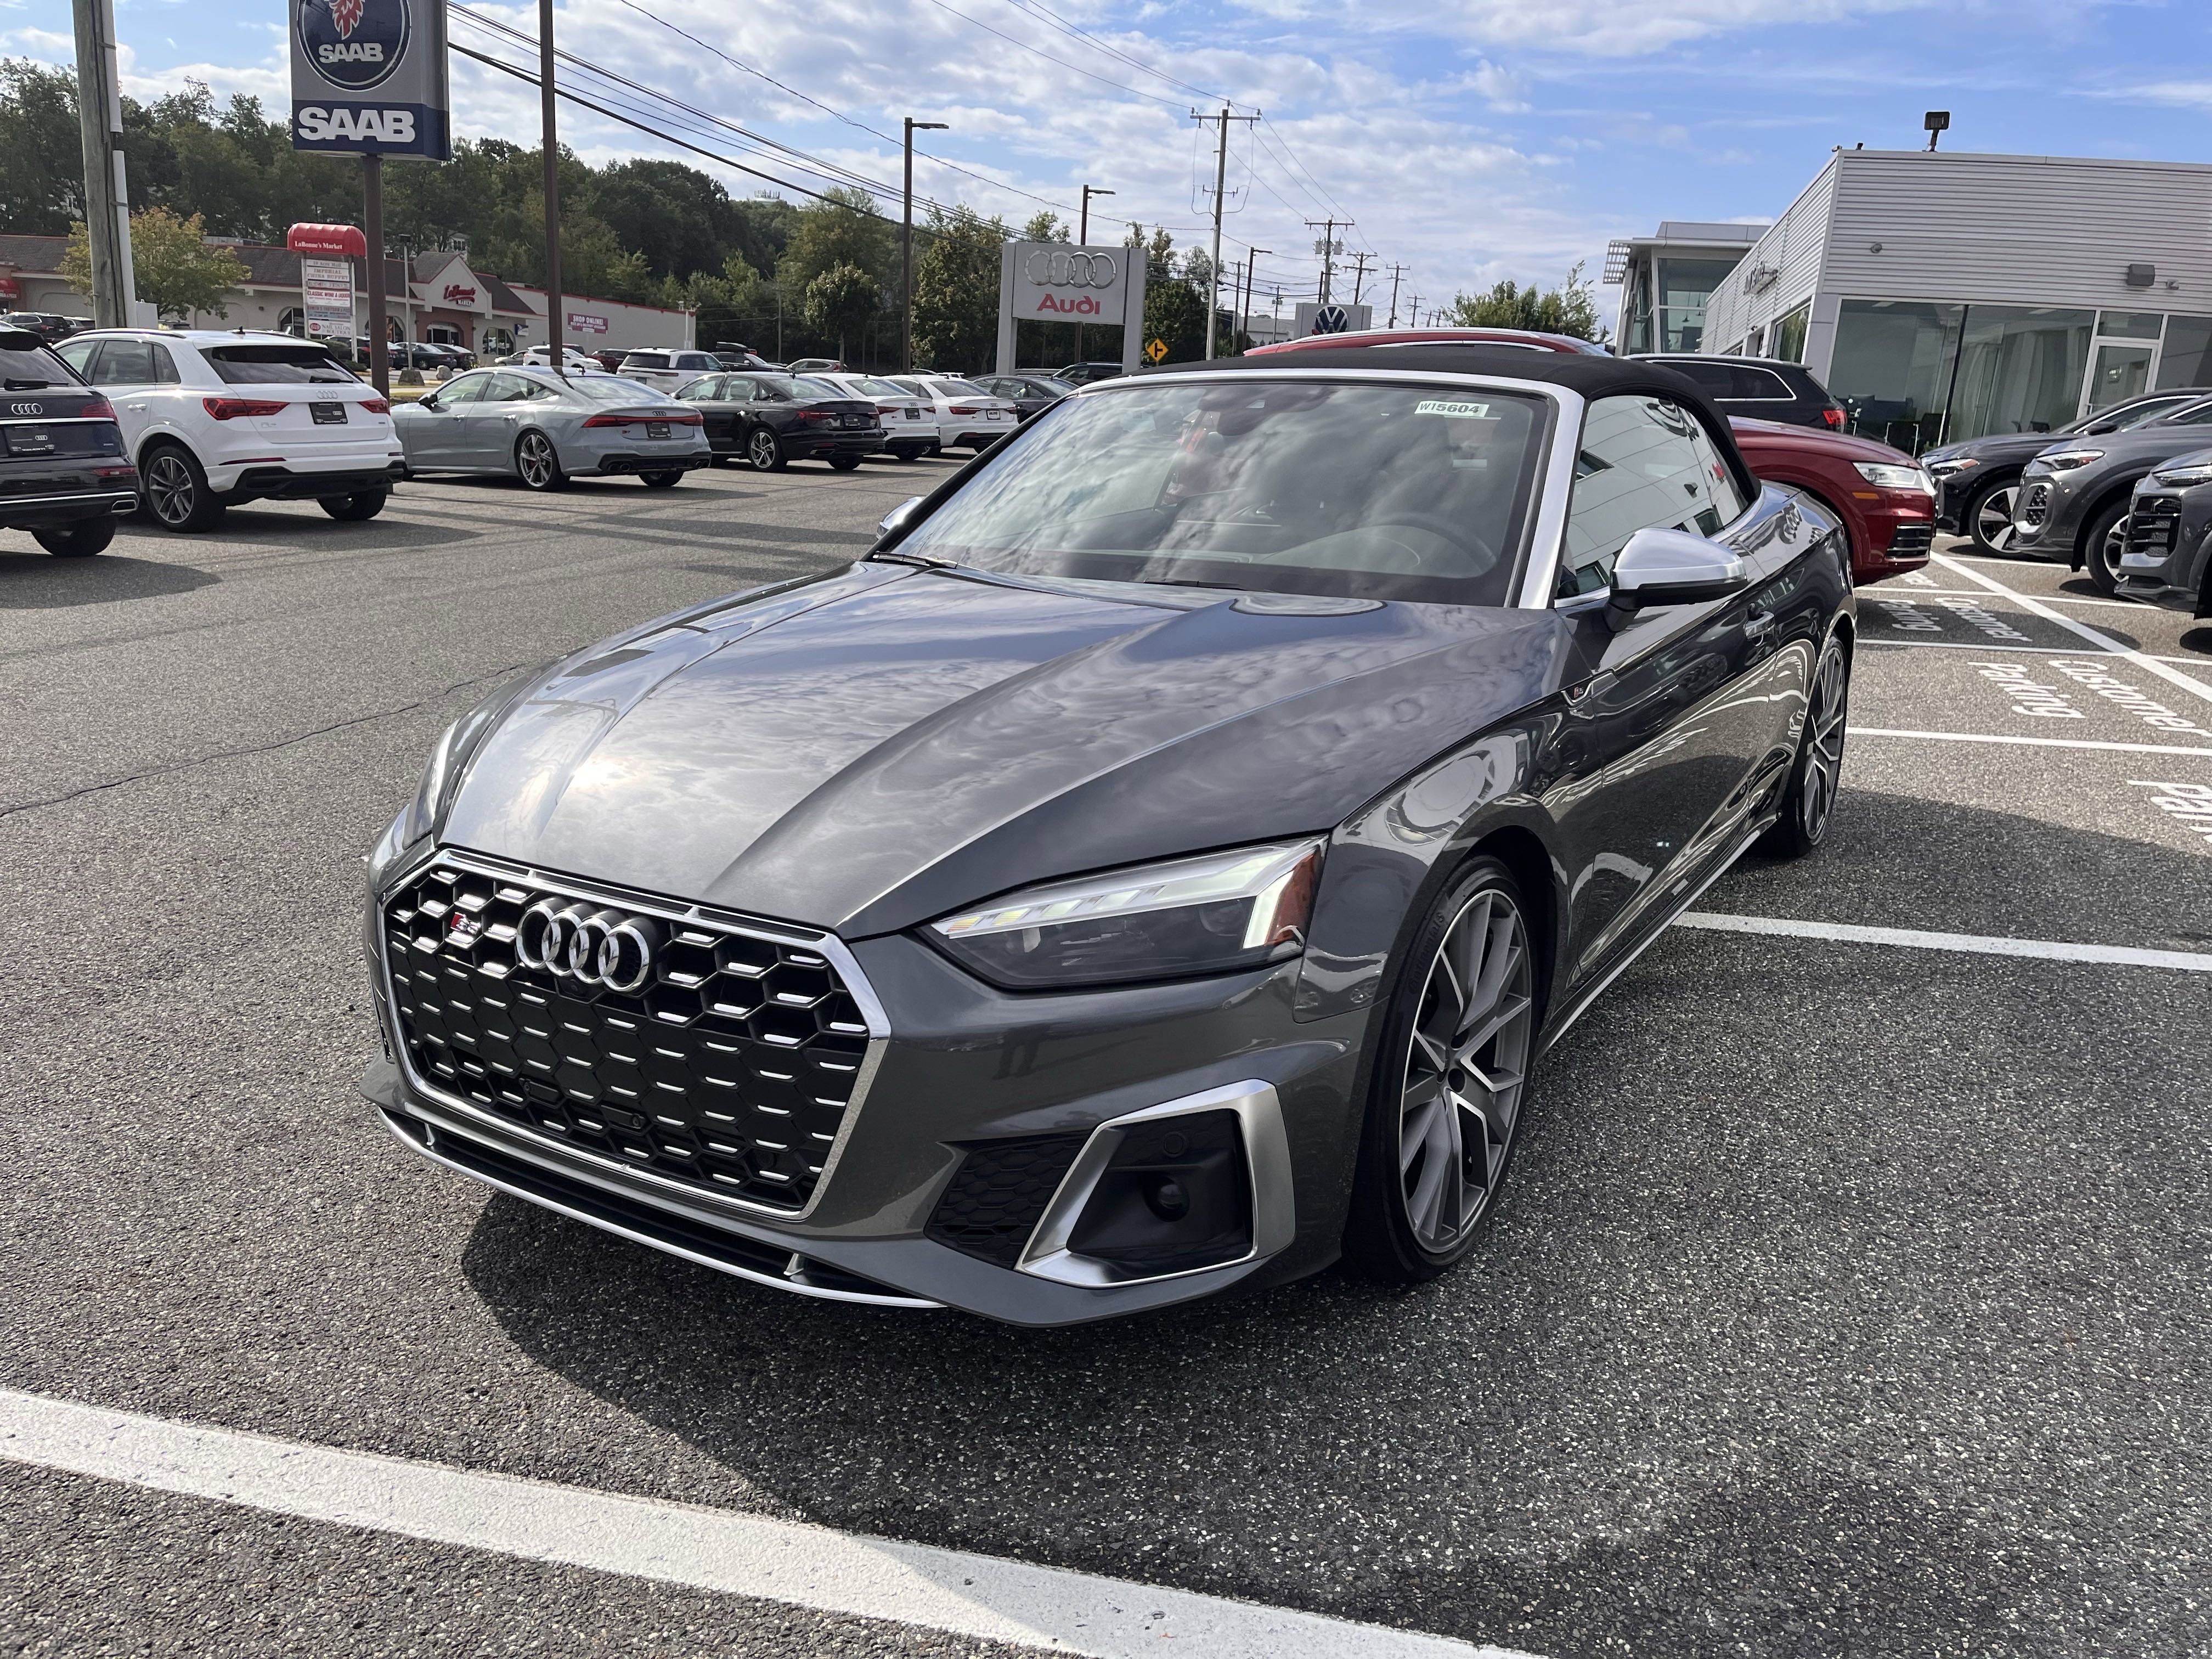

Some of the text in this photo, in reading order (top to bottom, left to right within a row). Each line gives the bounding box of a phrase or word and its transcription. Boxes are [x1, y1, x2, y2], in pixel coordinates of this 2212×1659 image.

[318, 43, 383, 64] SAAB
[298, 106, 416, 143] SAAB
[295, 240, 322, 249] LaBonne's
[1036, 293, 1101, 315] Audi
[573, 315, 585, 323] SHOP
[1420, 403, 1480, 413] W15604
[1872, 599, 1944, 631] Parking
[1934, 597, 2033, 642] Customer
[1966, 661, 2086, 719] Parking
[2047, 659, 2212, 737] Customer
